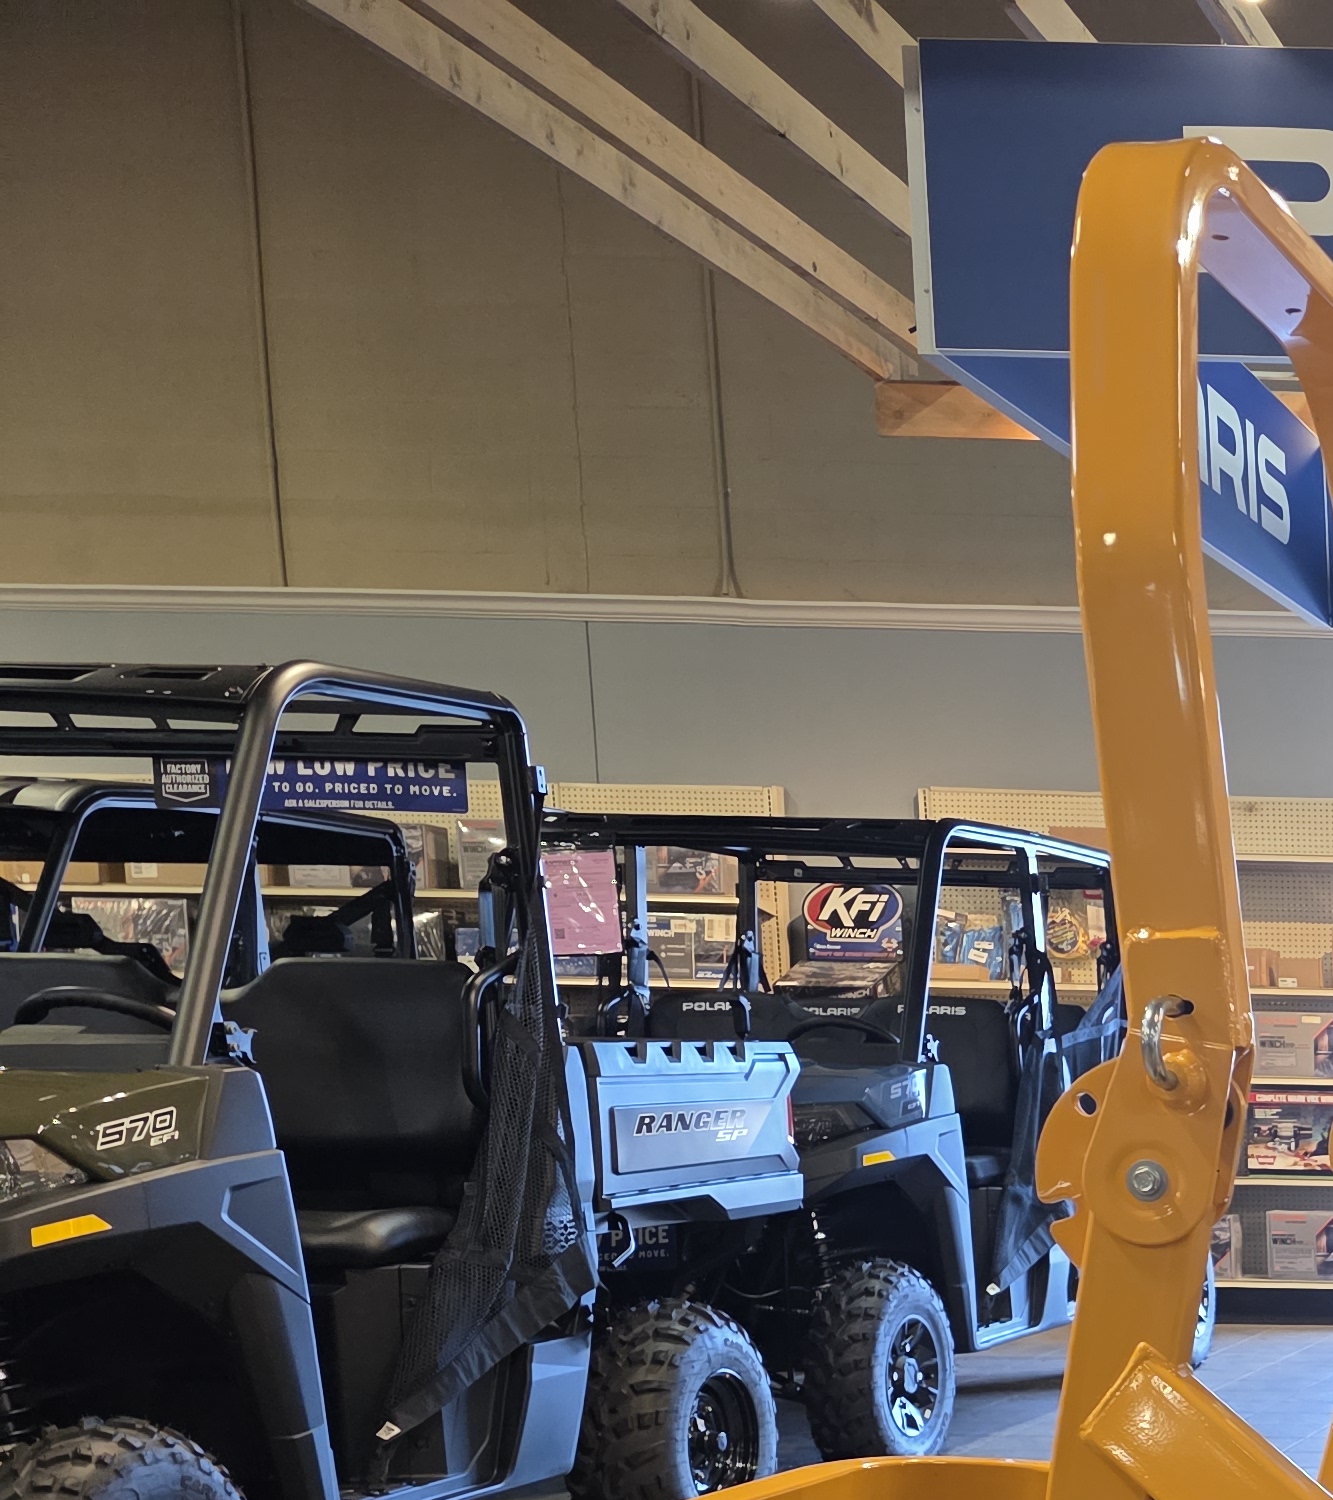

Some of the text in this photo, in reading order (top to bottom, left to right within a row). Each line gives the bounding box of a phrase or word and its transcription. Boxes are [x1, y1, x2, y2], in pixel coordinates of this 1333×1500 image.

[167, 764, 201, 774] FACTORY
[162, 774, 210, 784] AUTHORIZED
[166, 784, 206, 793] CLEARANCE
[273, 782, 290, 793] TO
[325, 783, 378, 794] PRICED
[385, 784, 402, 795] TO
[409, 784, 457, 797] MOVE.
[830, 928, 877, 938] WINCH
[96, 1106, 177, 1151] 570
[633, 1109, 746, 1136] RANGER
[150, 1131, 179, 1147] EFI
[715, 1128, 748, 1142] SP
[611, 1226, 669, 1247] PICE
